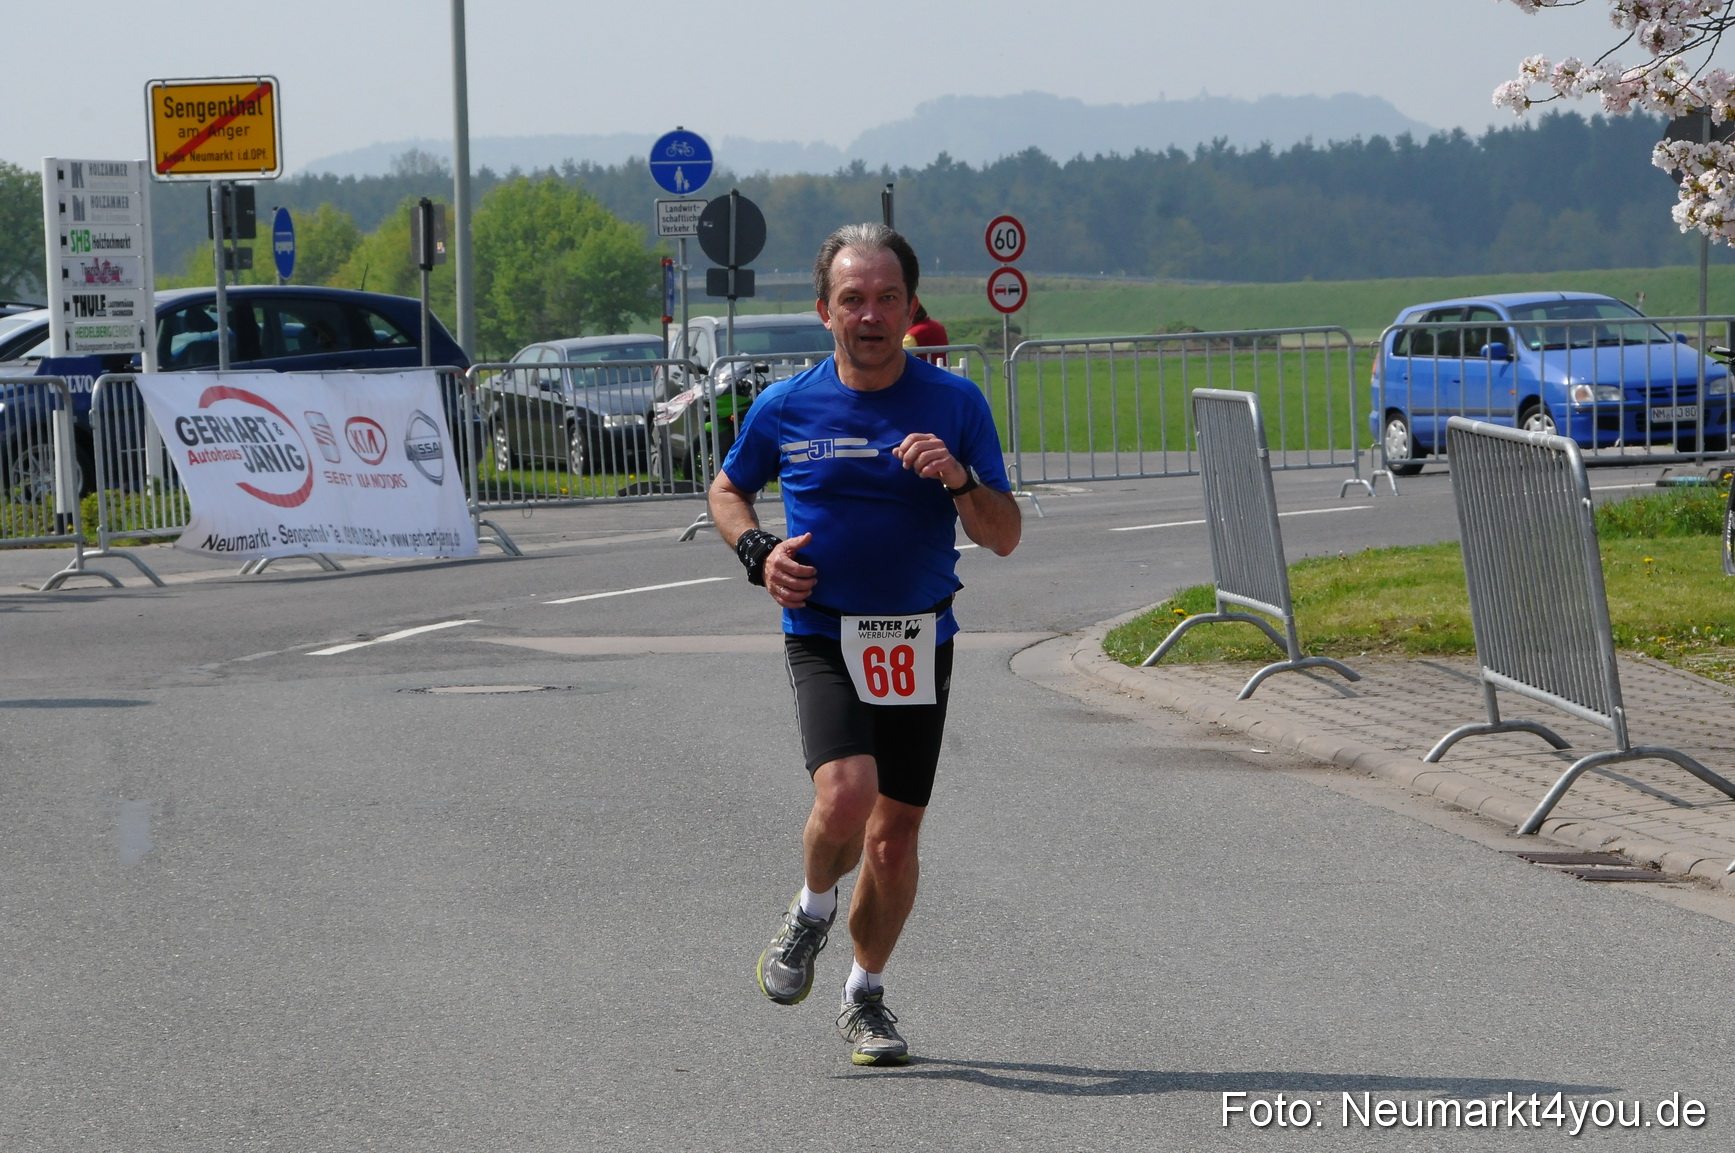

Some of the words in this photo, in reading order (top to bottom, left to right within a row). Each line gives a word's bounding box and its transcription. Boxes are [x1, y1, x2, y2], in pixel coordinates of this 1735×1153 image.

[164, 94, 263, 123] Sengenthal
[178, 127, 200, 138] am
[207, 125, 250, 140] Anger
[190, 150, 234, 162] Neumarkt
[88, 163, 128, 177] HOLZAMMER
[90, 195, 129, 209] HOLZAMMER
[665, 204, 700, 213] Landwirt-
[662, 224, 690, 233] Verkehr
[70, 229, 91, 253] SHB
[995, 228, 1017, 250] 60
[72, 294, 106, 317] THULE
[1652, 408, 1666, 419] NM
[175, 415, 277, 446] GERHART
[350, 429, 380, 454] KIA
[187, 447, 242, 465] Autohaus
[240, 444, 305, 473] JÄNIG
[201, 528, 271, 551] Neumarkt
[858, 620, 902, 631] MEYER
[858, 631, 902, 639] WERBUNG
[862, 644, 915, 698] 68
